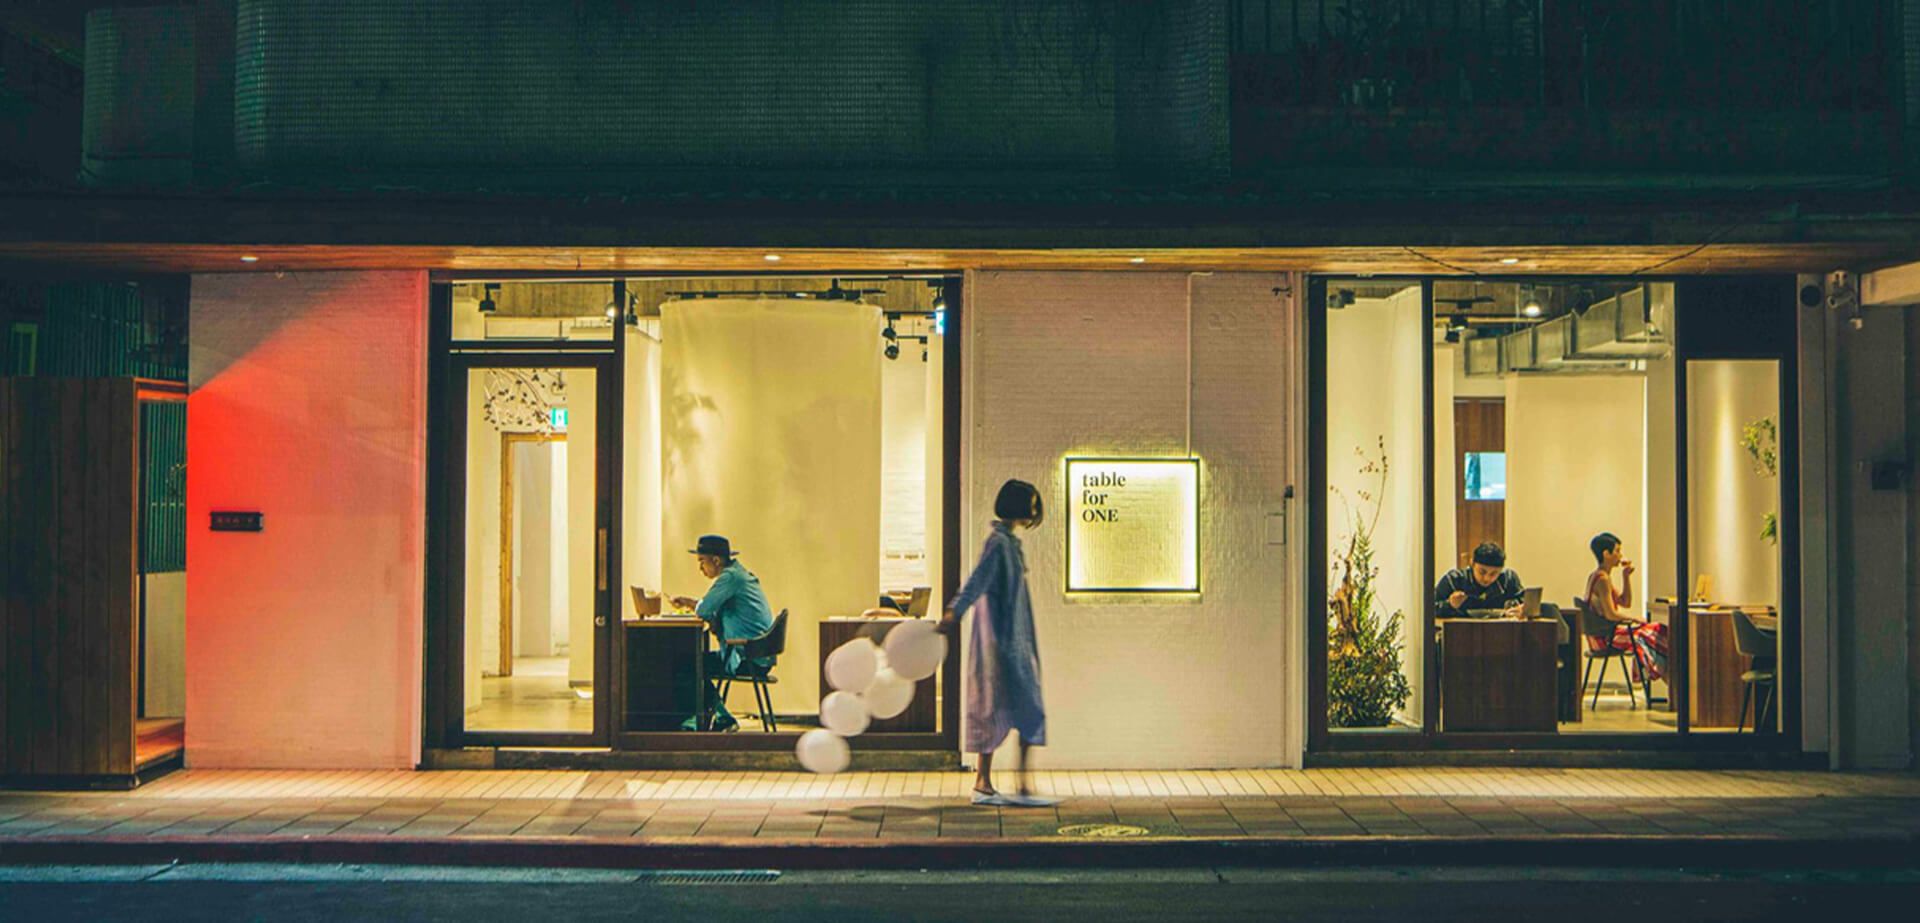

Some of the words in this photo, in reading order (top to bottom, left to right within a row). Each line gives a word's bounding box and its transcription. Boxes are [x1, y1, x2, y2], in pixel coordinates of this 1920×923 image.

[1082, 471, 1126, 487] table
[1082, 489, 1108, 505] for
[1082, 509, 1118, 522] ONE
